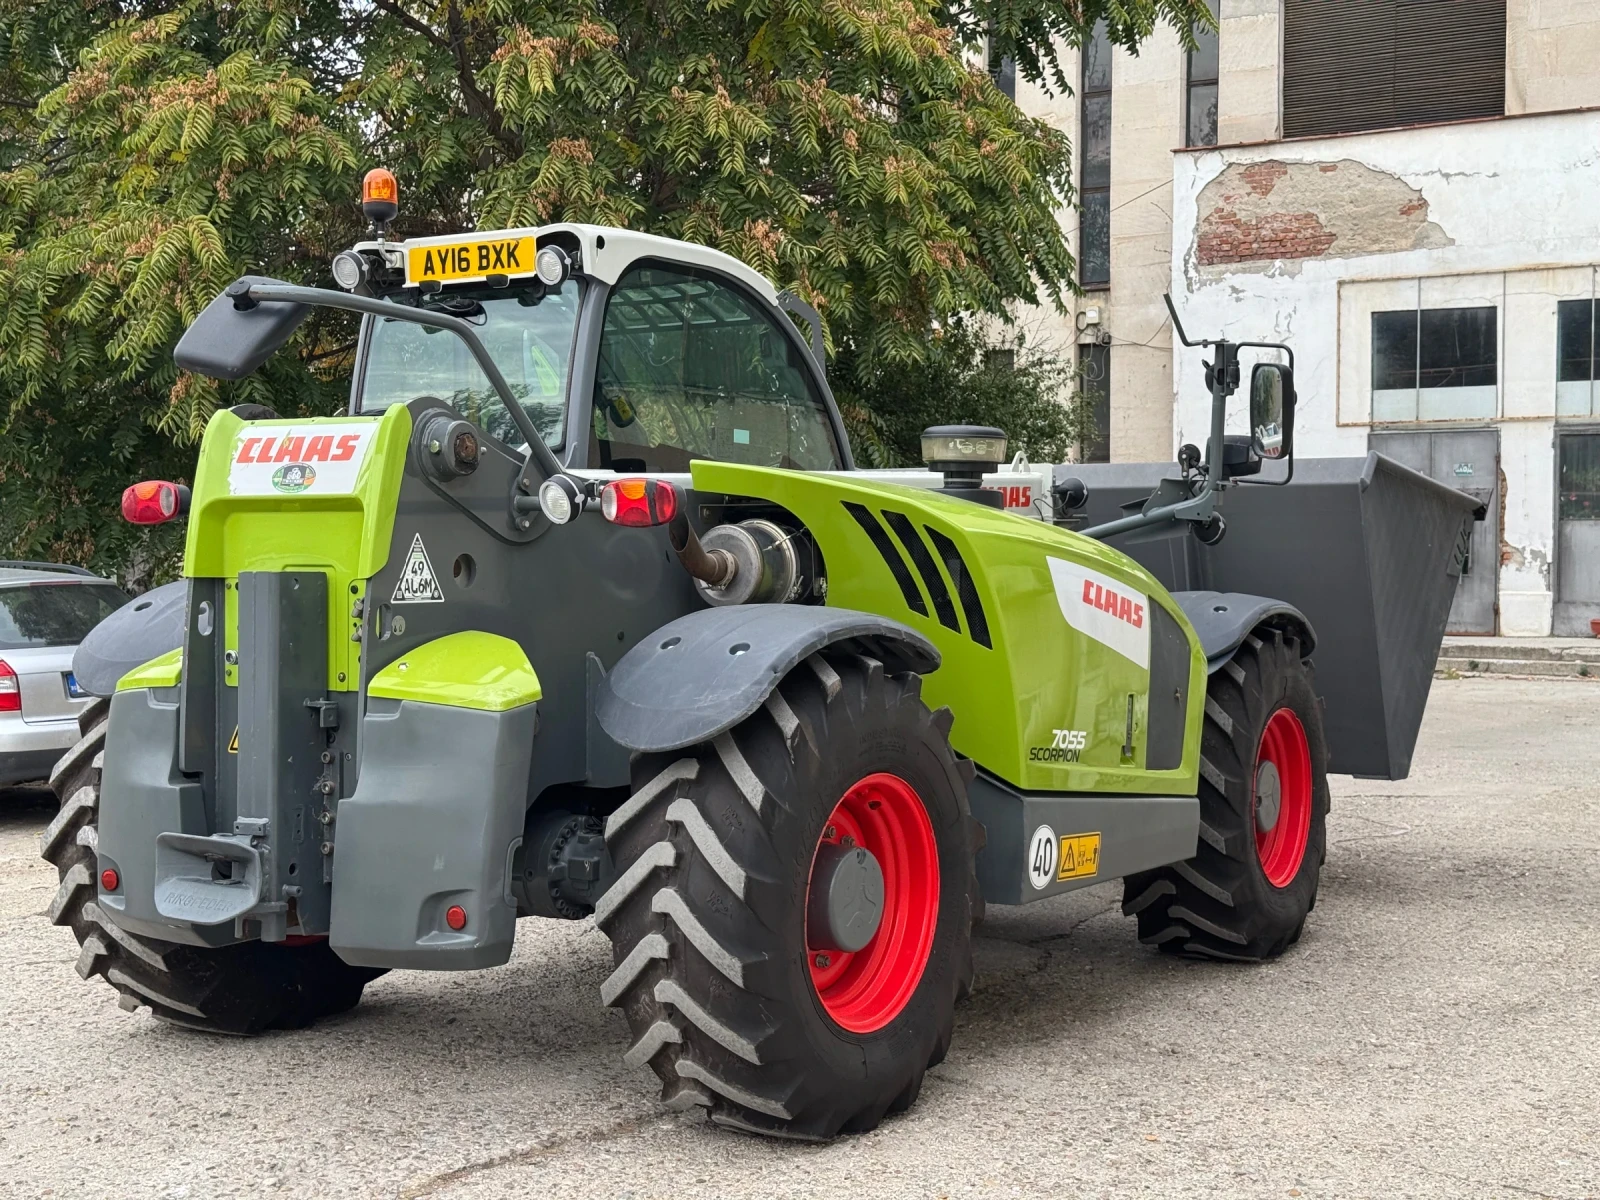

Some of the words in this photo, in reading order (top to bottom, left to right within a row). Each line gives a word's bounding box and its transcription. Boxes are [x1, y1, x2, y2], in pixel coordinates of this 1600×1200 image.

[423, 247, 471, 276] AY16
[477, 240, 520, 271] BXK
[236, 435, 361, 463] CLAAS
[411, 560, 425, 576] 49
[1082, 578, 1144, 629] CLAAS
[1051, 729, 1087, 749] 7055
[1029, 747, 1080, 762] SCORPION
[1033, 837, 1053, 877] 40
